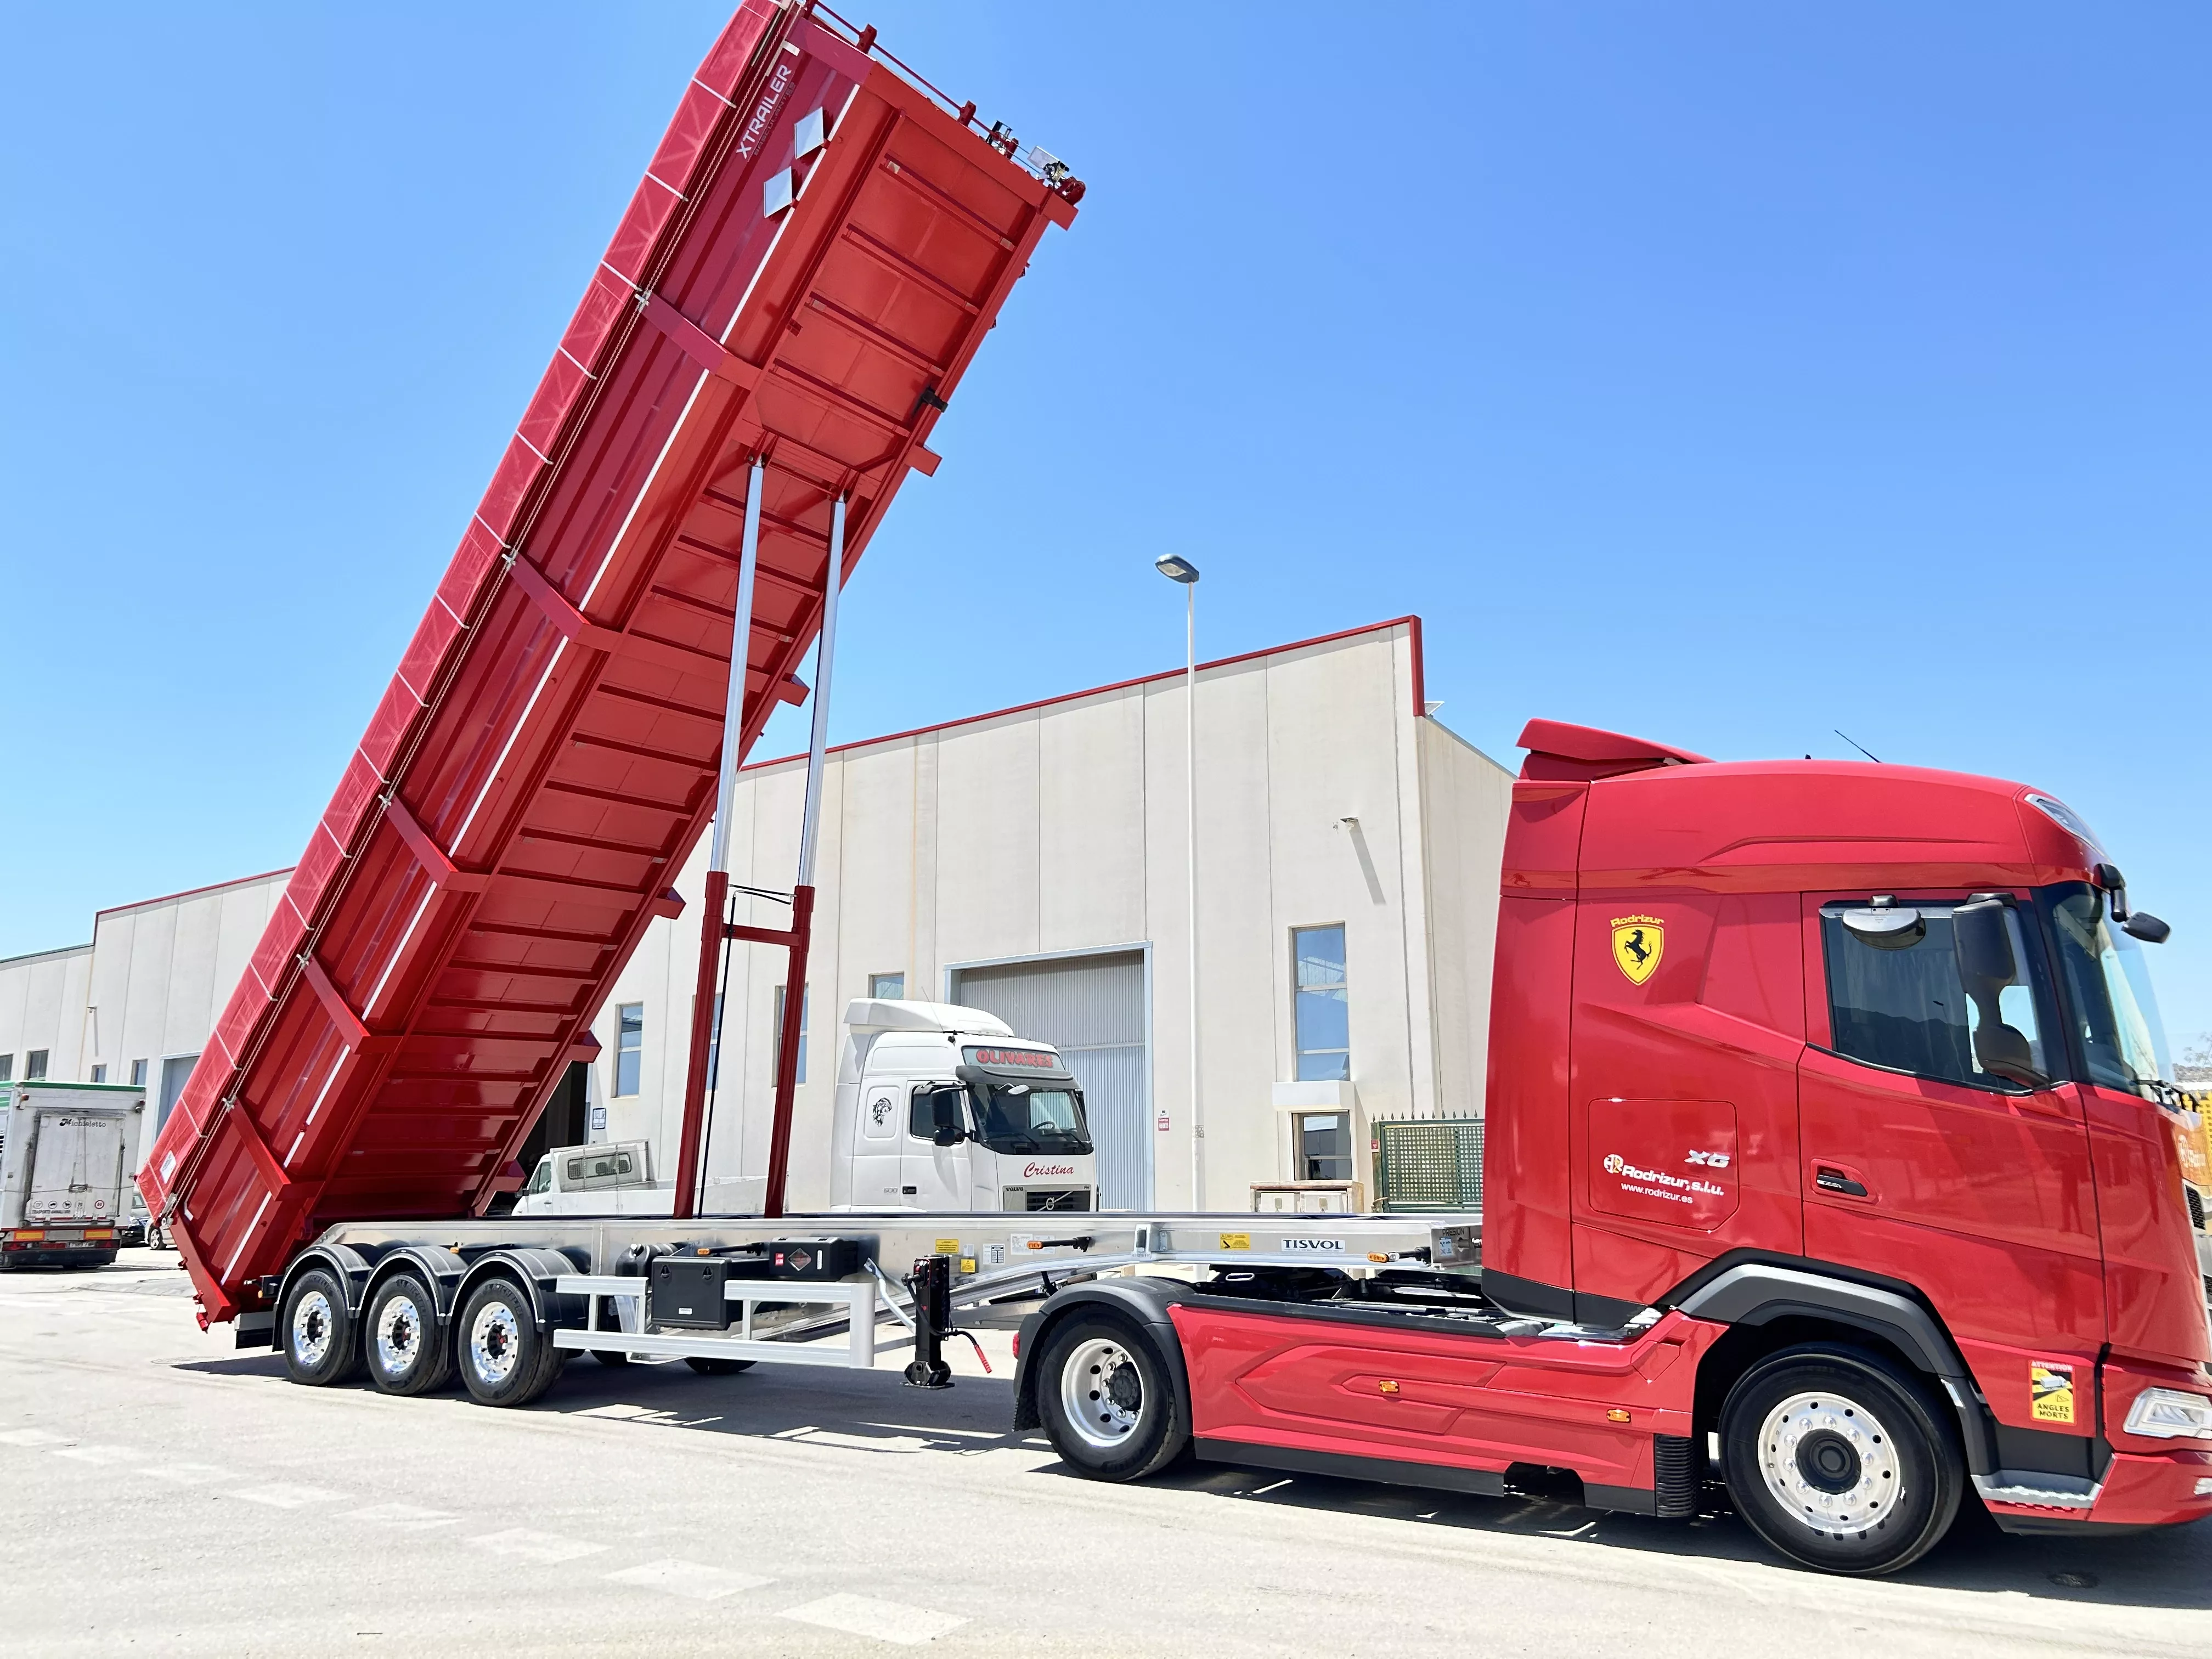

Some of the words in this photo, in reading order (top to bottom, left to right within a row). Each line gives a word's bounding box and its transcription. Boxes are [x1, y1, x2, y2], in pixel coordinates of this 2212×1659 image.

[736, 64, 792, 159] XTRAILER
[1610, 914, 1664, 927] Rodrizur
[976, 1048, 1053, 1068] OLIVARES
[1684, 1149, 1730, 1168] XG
[1024, 1162, 1074, 1178] Cristina
[1621, 1182, 1693, 1204] www.rodrizur.es
[1283, 1239, 1344, 1249] TISVOL
[2037, 1403, 2070, 1413] ANGLES
[2039, 1410, 2068, 1419] MORTS
